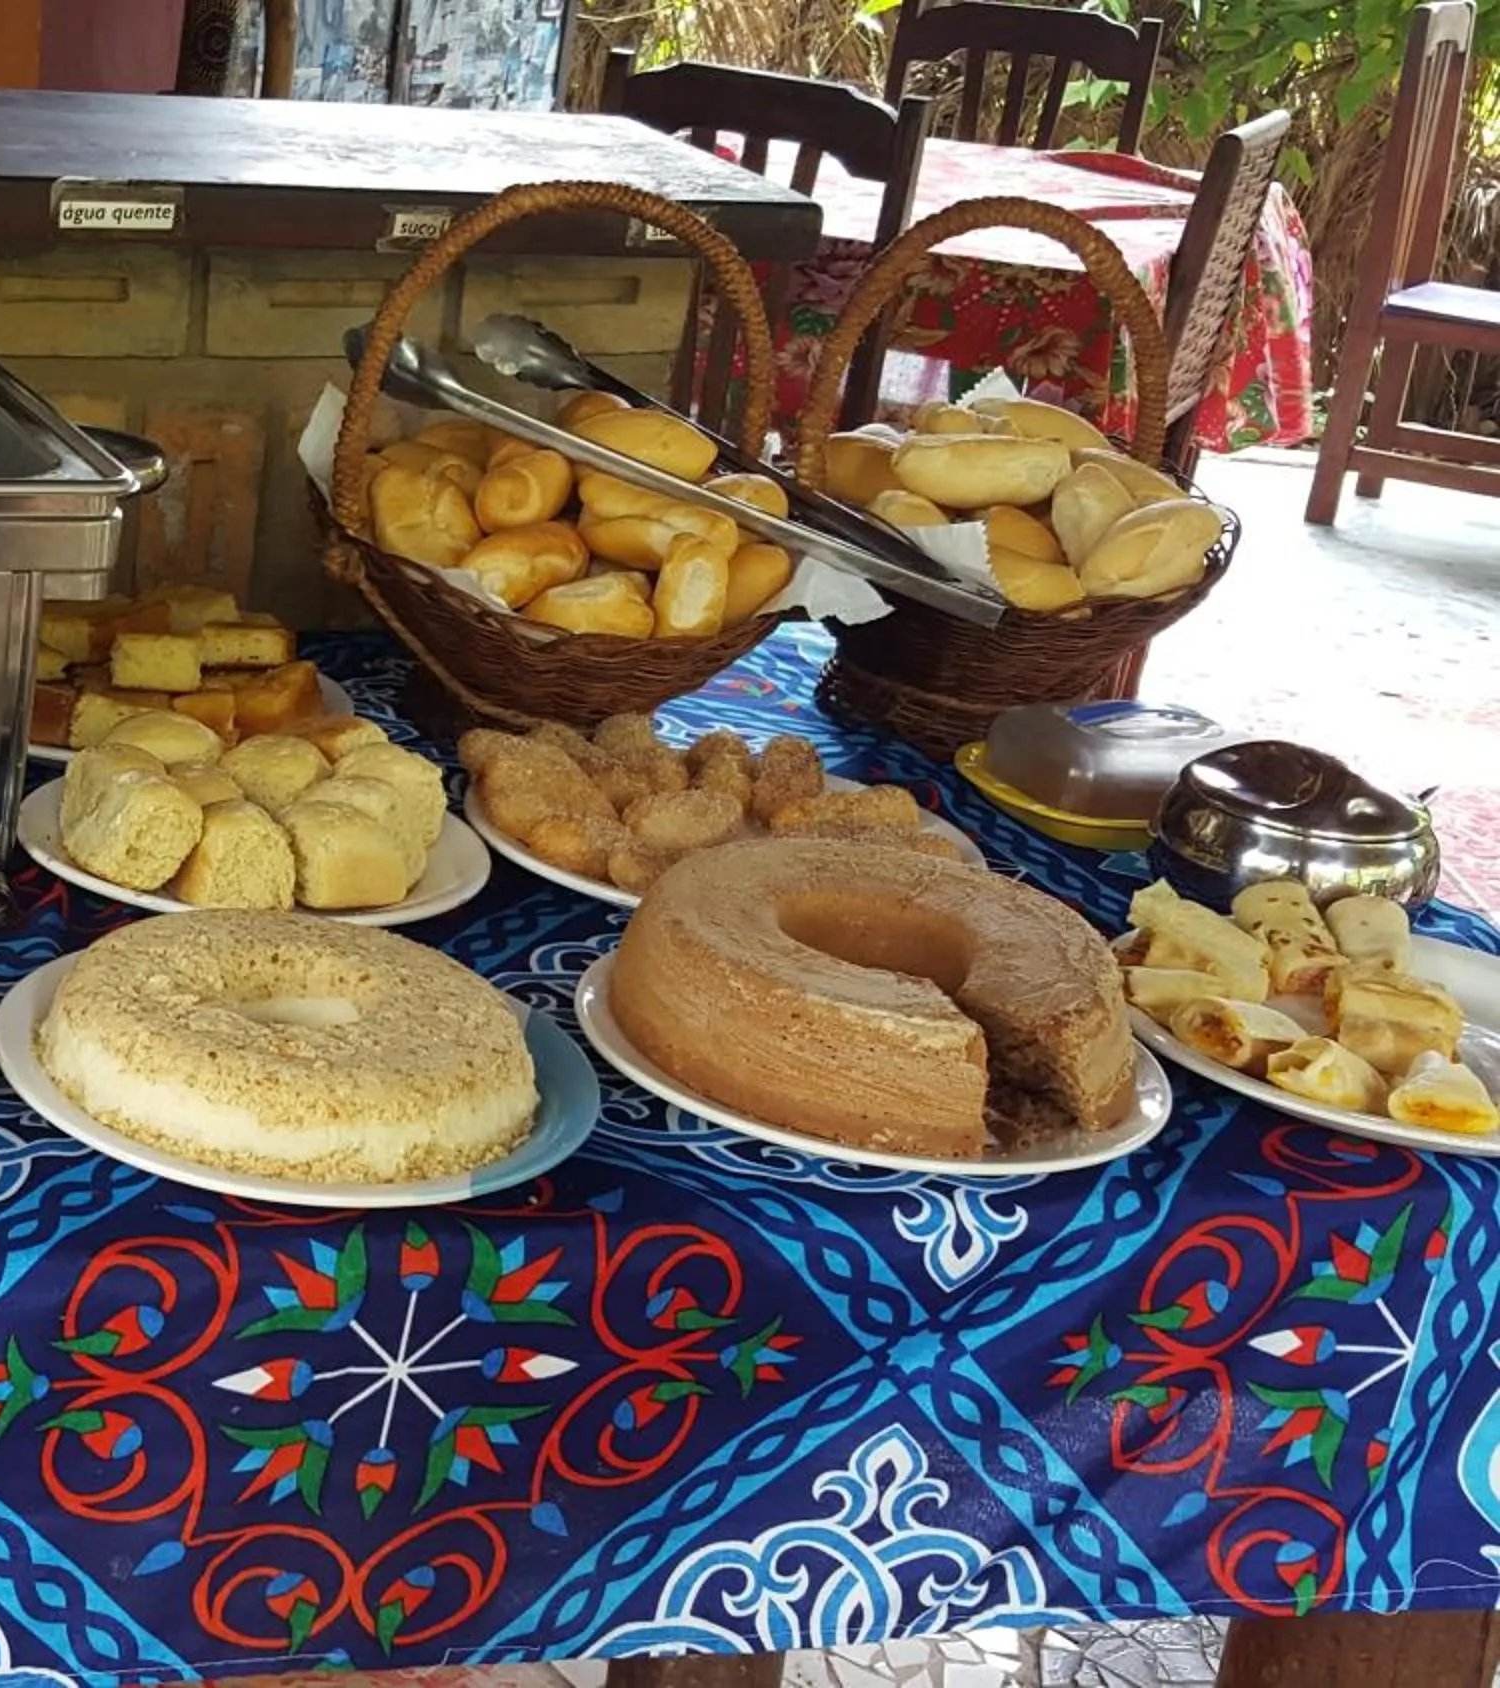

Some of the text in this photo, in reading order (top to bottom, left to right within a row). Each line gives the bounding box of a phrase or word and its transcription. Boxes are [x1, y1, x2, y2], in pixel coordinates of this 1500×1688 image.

[63, 203, 173, 224] água quente
[400, 223, 437, 236] suco
